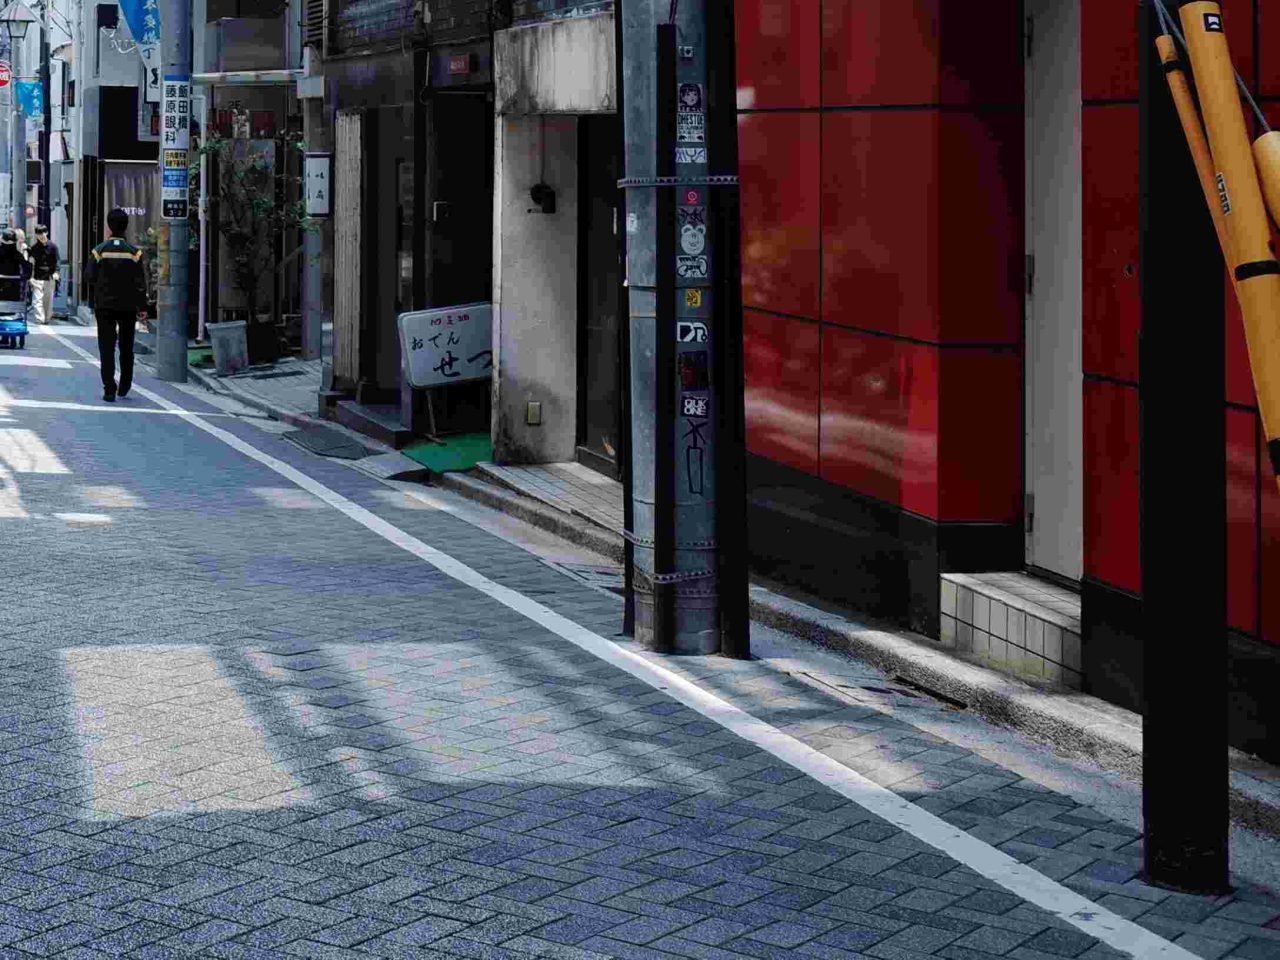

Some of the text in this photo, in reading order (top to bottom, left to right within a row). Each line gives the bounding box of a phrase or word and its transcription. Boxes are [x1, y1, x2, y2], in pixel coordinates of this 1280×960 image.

[165, 85, 176, 144] 藤原眼科
[178, 85, 188, 130] 飯田橋
[412, 331, 460, 350] おでん
